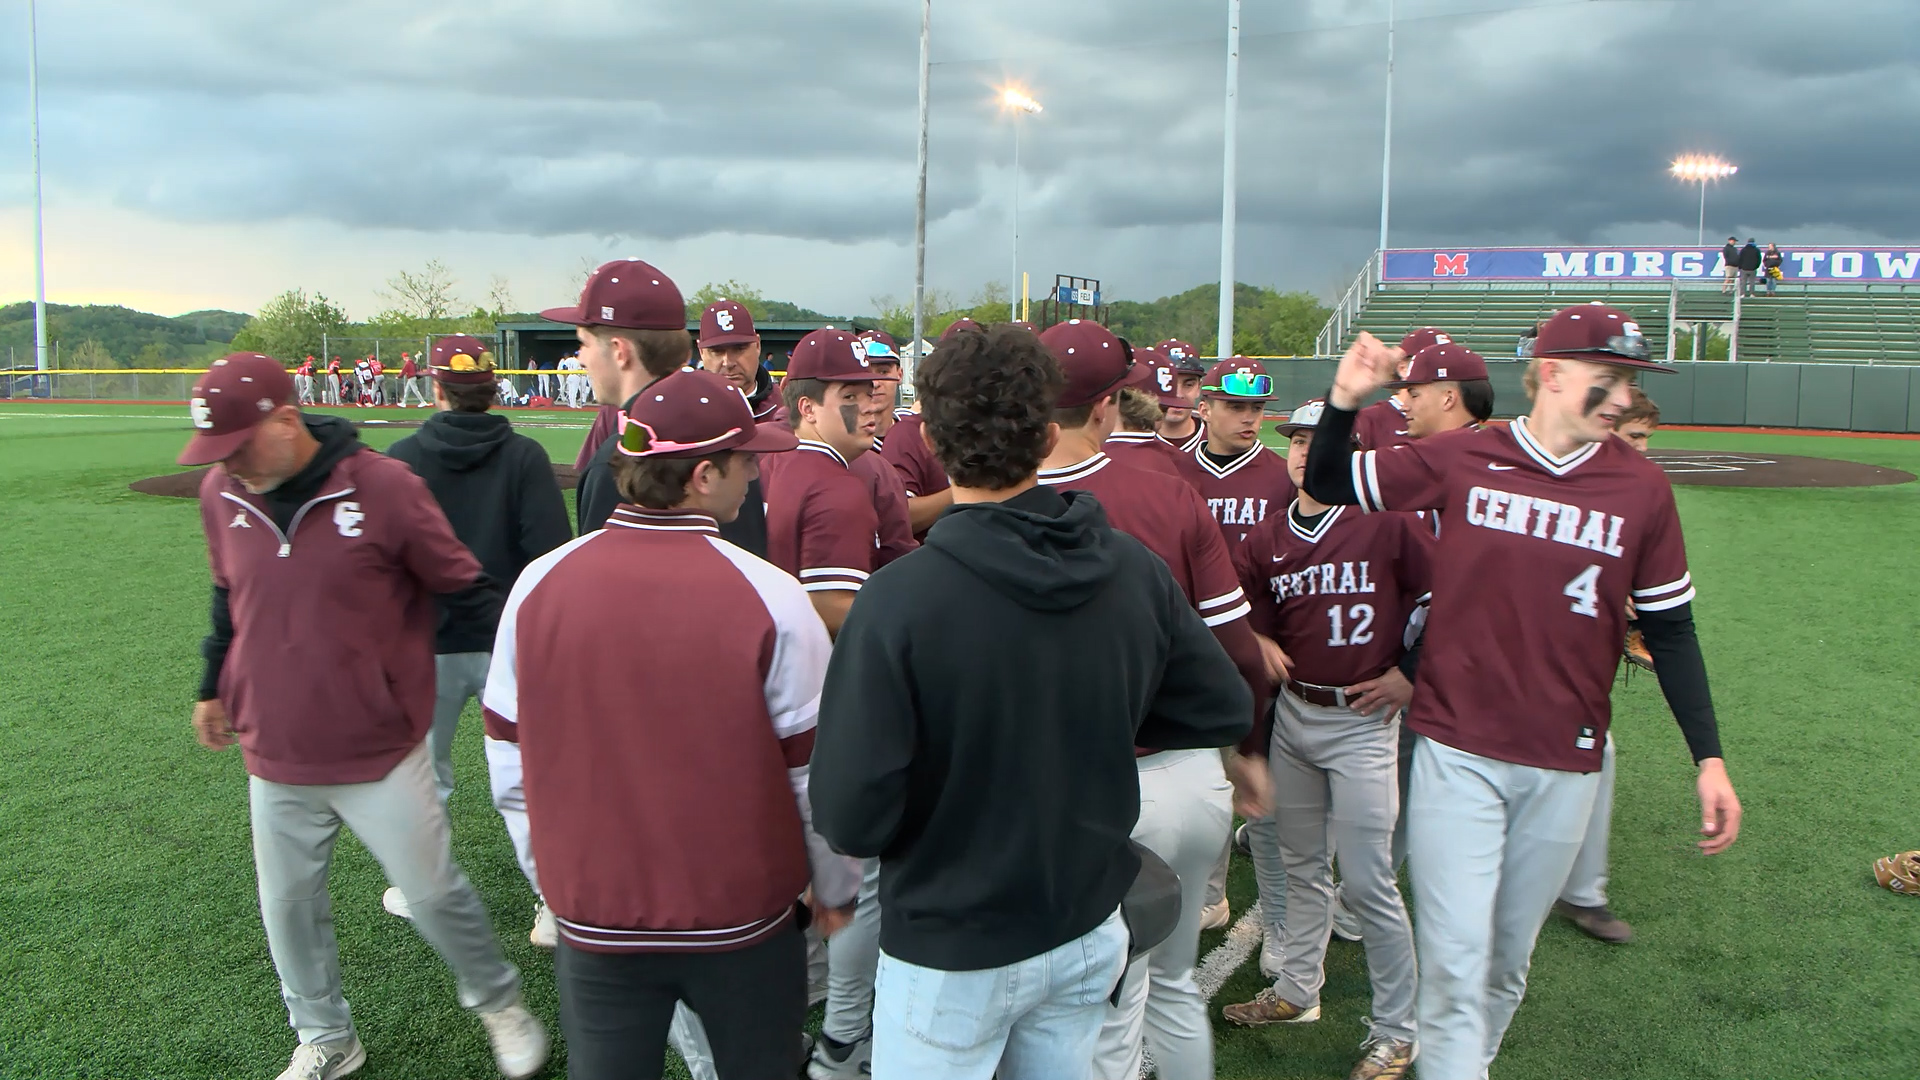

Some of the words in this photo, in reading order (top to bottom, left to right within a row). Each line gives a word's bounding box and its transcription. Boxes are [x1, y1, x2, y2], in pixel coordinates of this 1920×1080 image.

[1434, 253, 1469, 277] M
[1542, 251, 1920, 279] MORGTOW
[1466, 486, 1625, 558] CENTRAL
[1563, 564, 1603, 618] 4
[1327, 603, 1375, 647] 12
